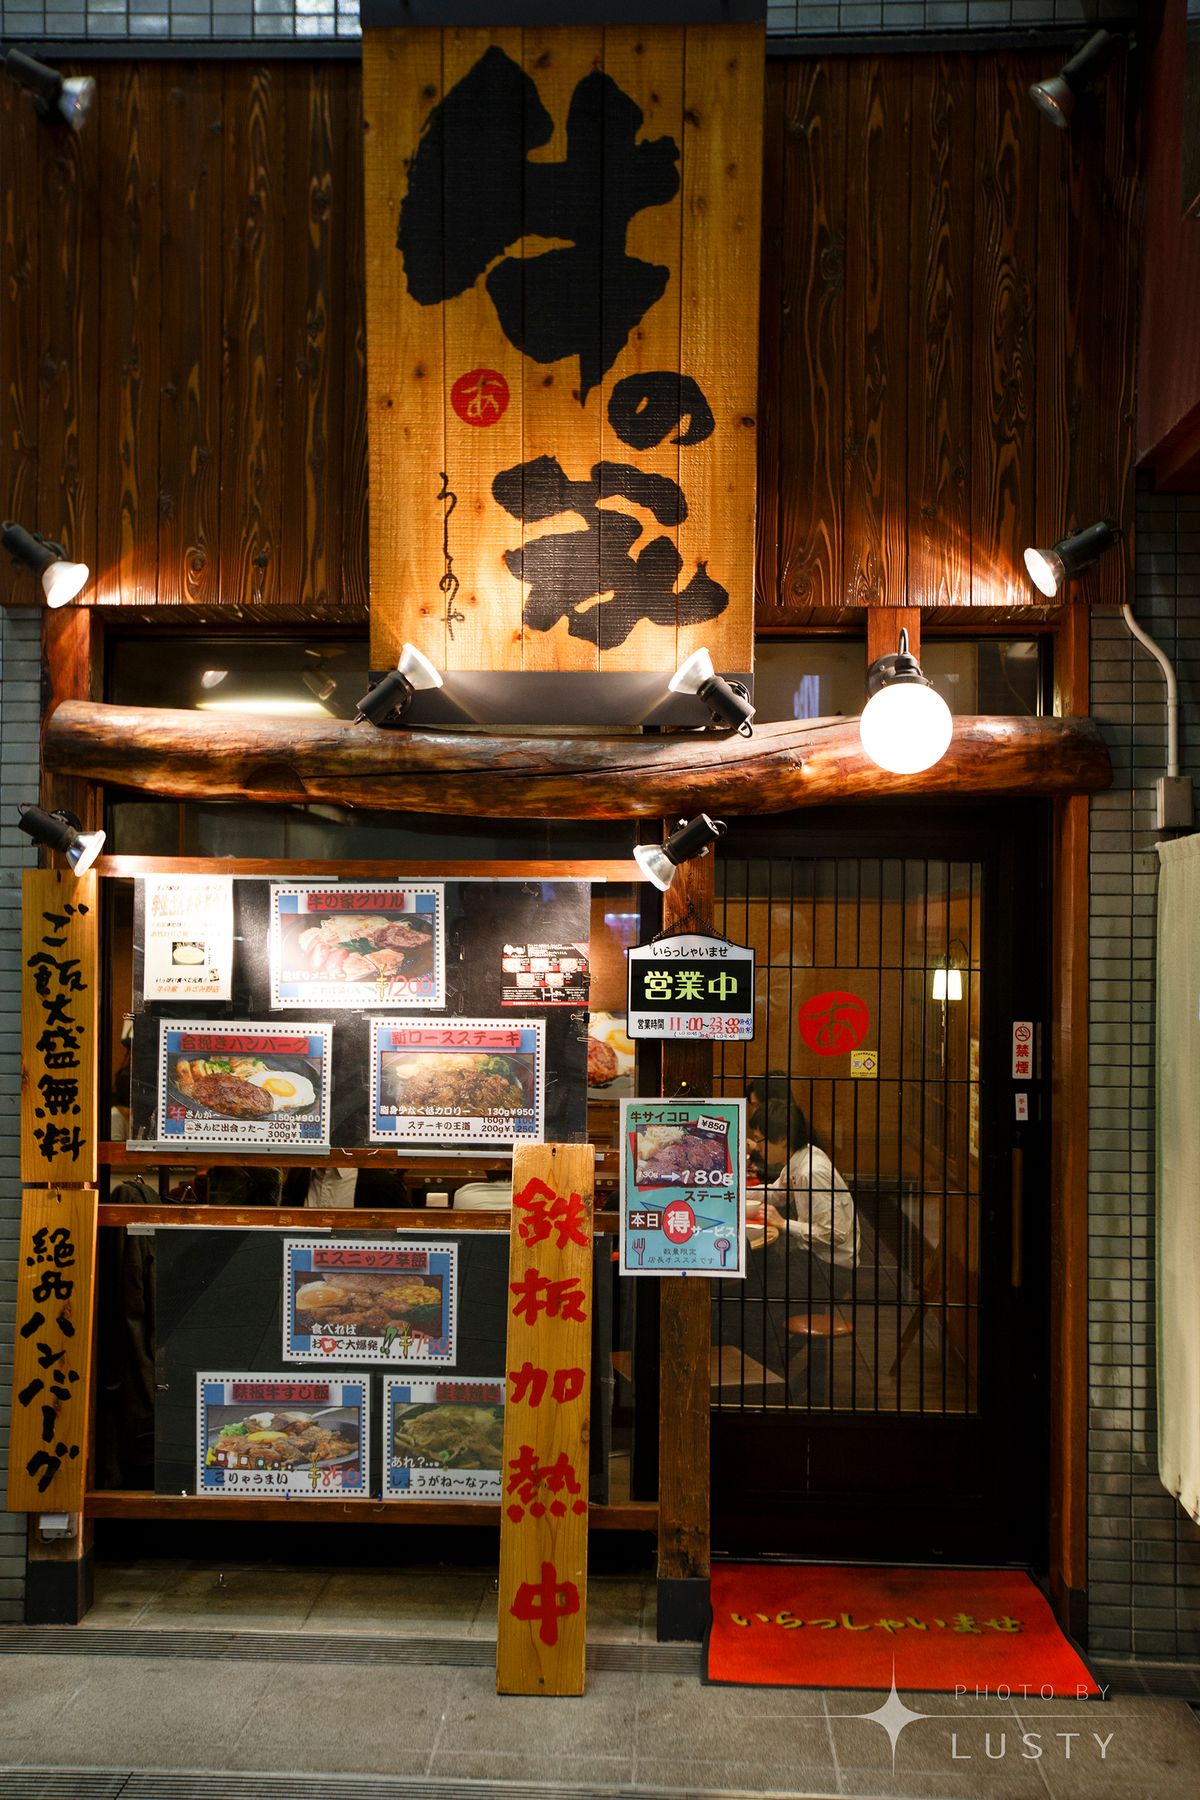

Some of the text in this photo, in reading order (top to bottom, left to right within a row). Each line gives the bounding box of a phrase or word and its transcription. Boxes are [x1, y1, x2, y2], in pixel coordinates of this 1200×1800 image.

[653, 947, 728, 957] いらっしゃいませ
[644, 971, 738, 1001] 営業中
[638, 1019, 665, 1030] 営業時間
[1016, 1044, 1029, 1074] 禁煙
[631, 1111, 689, 1123] 牛サイコロ
[408, 1121, 471, 1131] ステーキの王道
[701, 1119, 725, 1132] ¥850
[684, 1190, 736, 1203] ステーキ
[631, 1210, 735, 1237] 本日 得 サービス
[311, 1323, 357, 1335] 食べれば
[18, 1227, 80, 1493] 絶品ハンバーグ
[507, 1177, 590, 1646] 鉄板加熱中
[731, 1611, 1022, 1633] いらっしゃいませ
